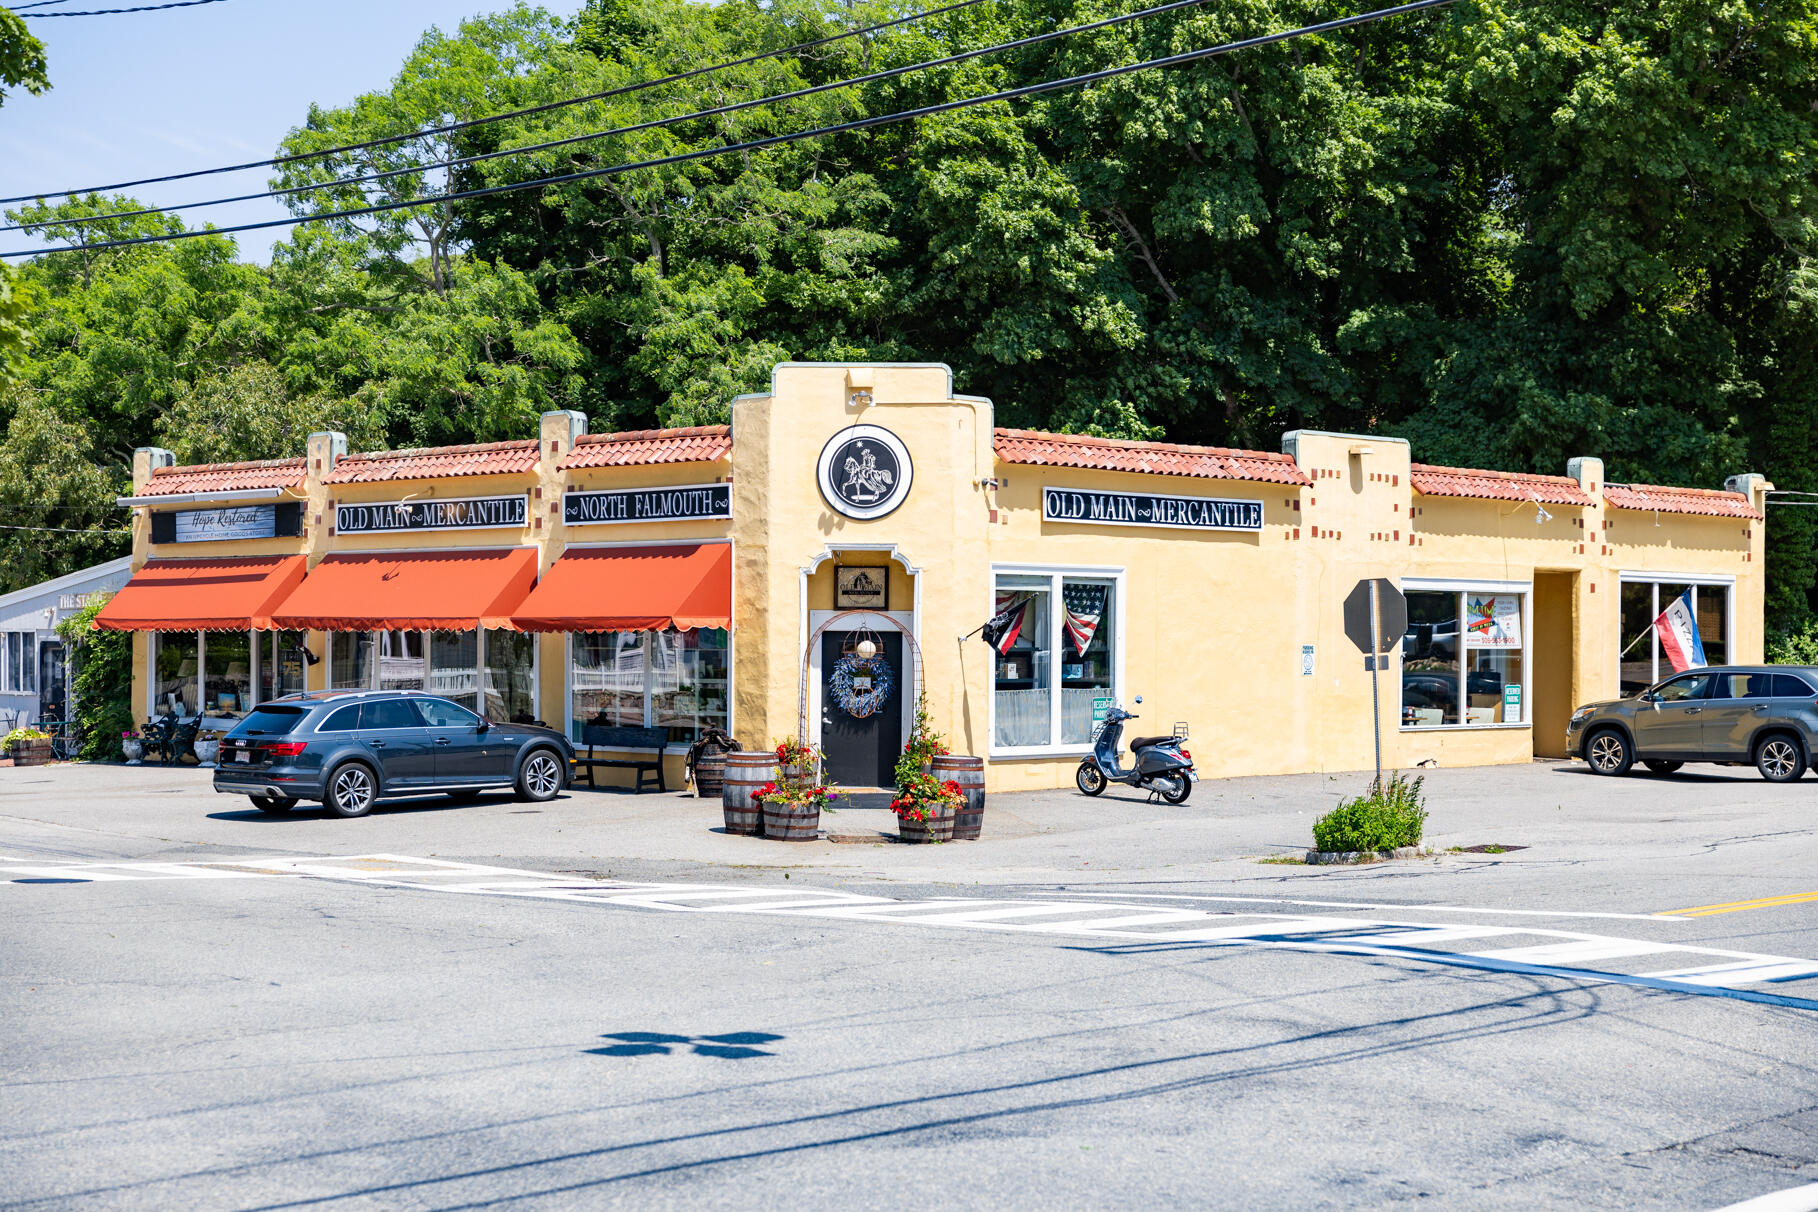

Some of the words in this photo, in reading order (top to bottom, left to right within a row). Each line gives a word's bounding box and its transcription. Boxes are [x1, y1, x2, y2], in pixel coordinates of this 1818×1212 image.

[192, 511, 215, 531] Hope
[217, 508, 259, 527] Restored
[338, 507, 368, 530] OLD
[371, 504, 411, 528] MAIN
[422, 499, 525, 526] MERCANTILE
[580, 495, 628, 520] NORTH
[634, 490, 714, 518] FALMOUTH
[1047, 492, 1085, 518] OLD
[1089, 495, 1137, 521] MAIN
[1150, 499, 1261, 527] MERCANTILE
[59, 594, 75, 609] THE
[1674, 609, 1694, 648] PIZ
[282, 661, 301, 676] 75
